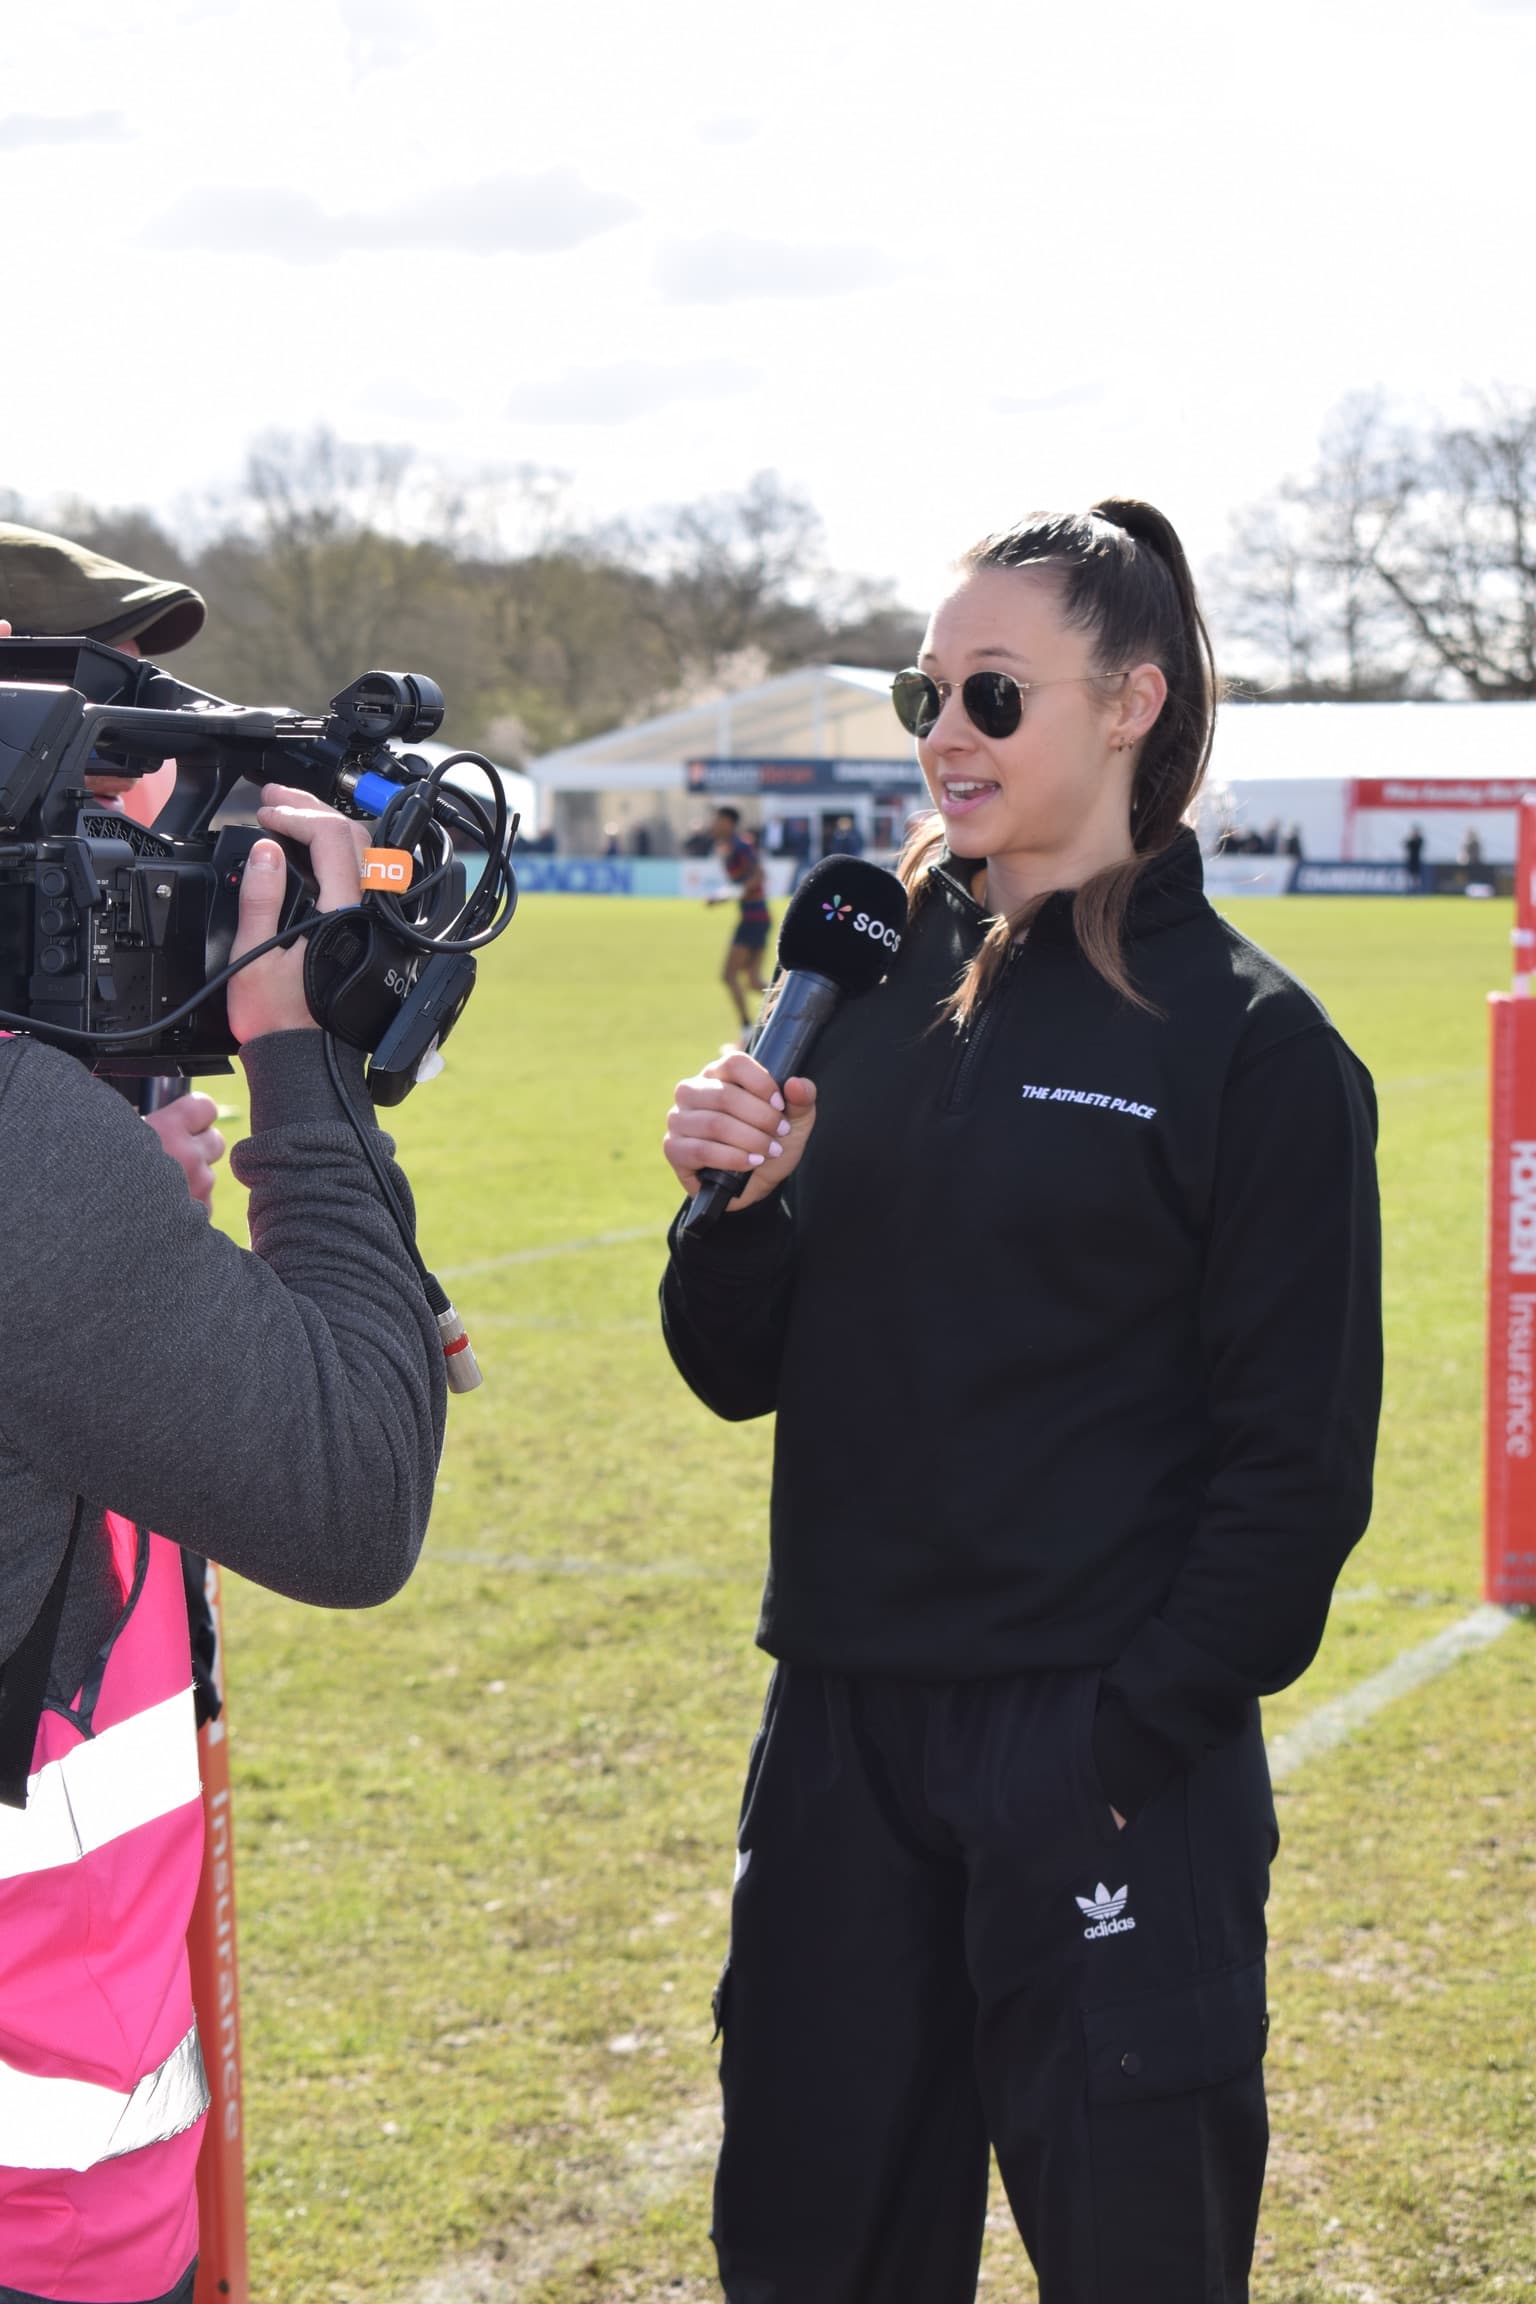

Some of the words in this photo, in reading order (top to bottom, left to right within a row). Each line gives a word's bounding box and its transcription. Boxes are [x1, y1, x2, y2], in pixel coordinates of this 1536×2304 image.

[360, 858, 404, 881] ino
[853, 912, 902, 953] SOCS
[1022, 1084, 1050, 1100] THE
[1049, 1087, 1112, 1108] ATHLETE
[1110, 1098, 1157, 1120] PLACE
[1505, 1292, 1536, 1459] Insurance
[1084, 1917, 1136, 1939] adidas
